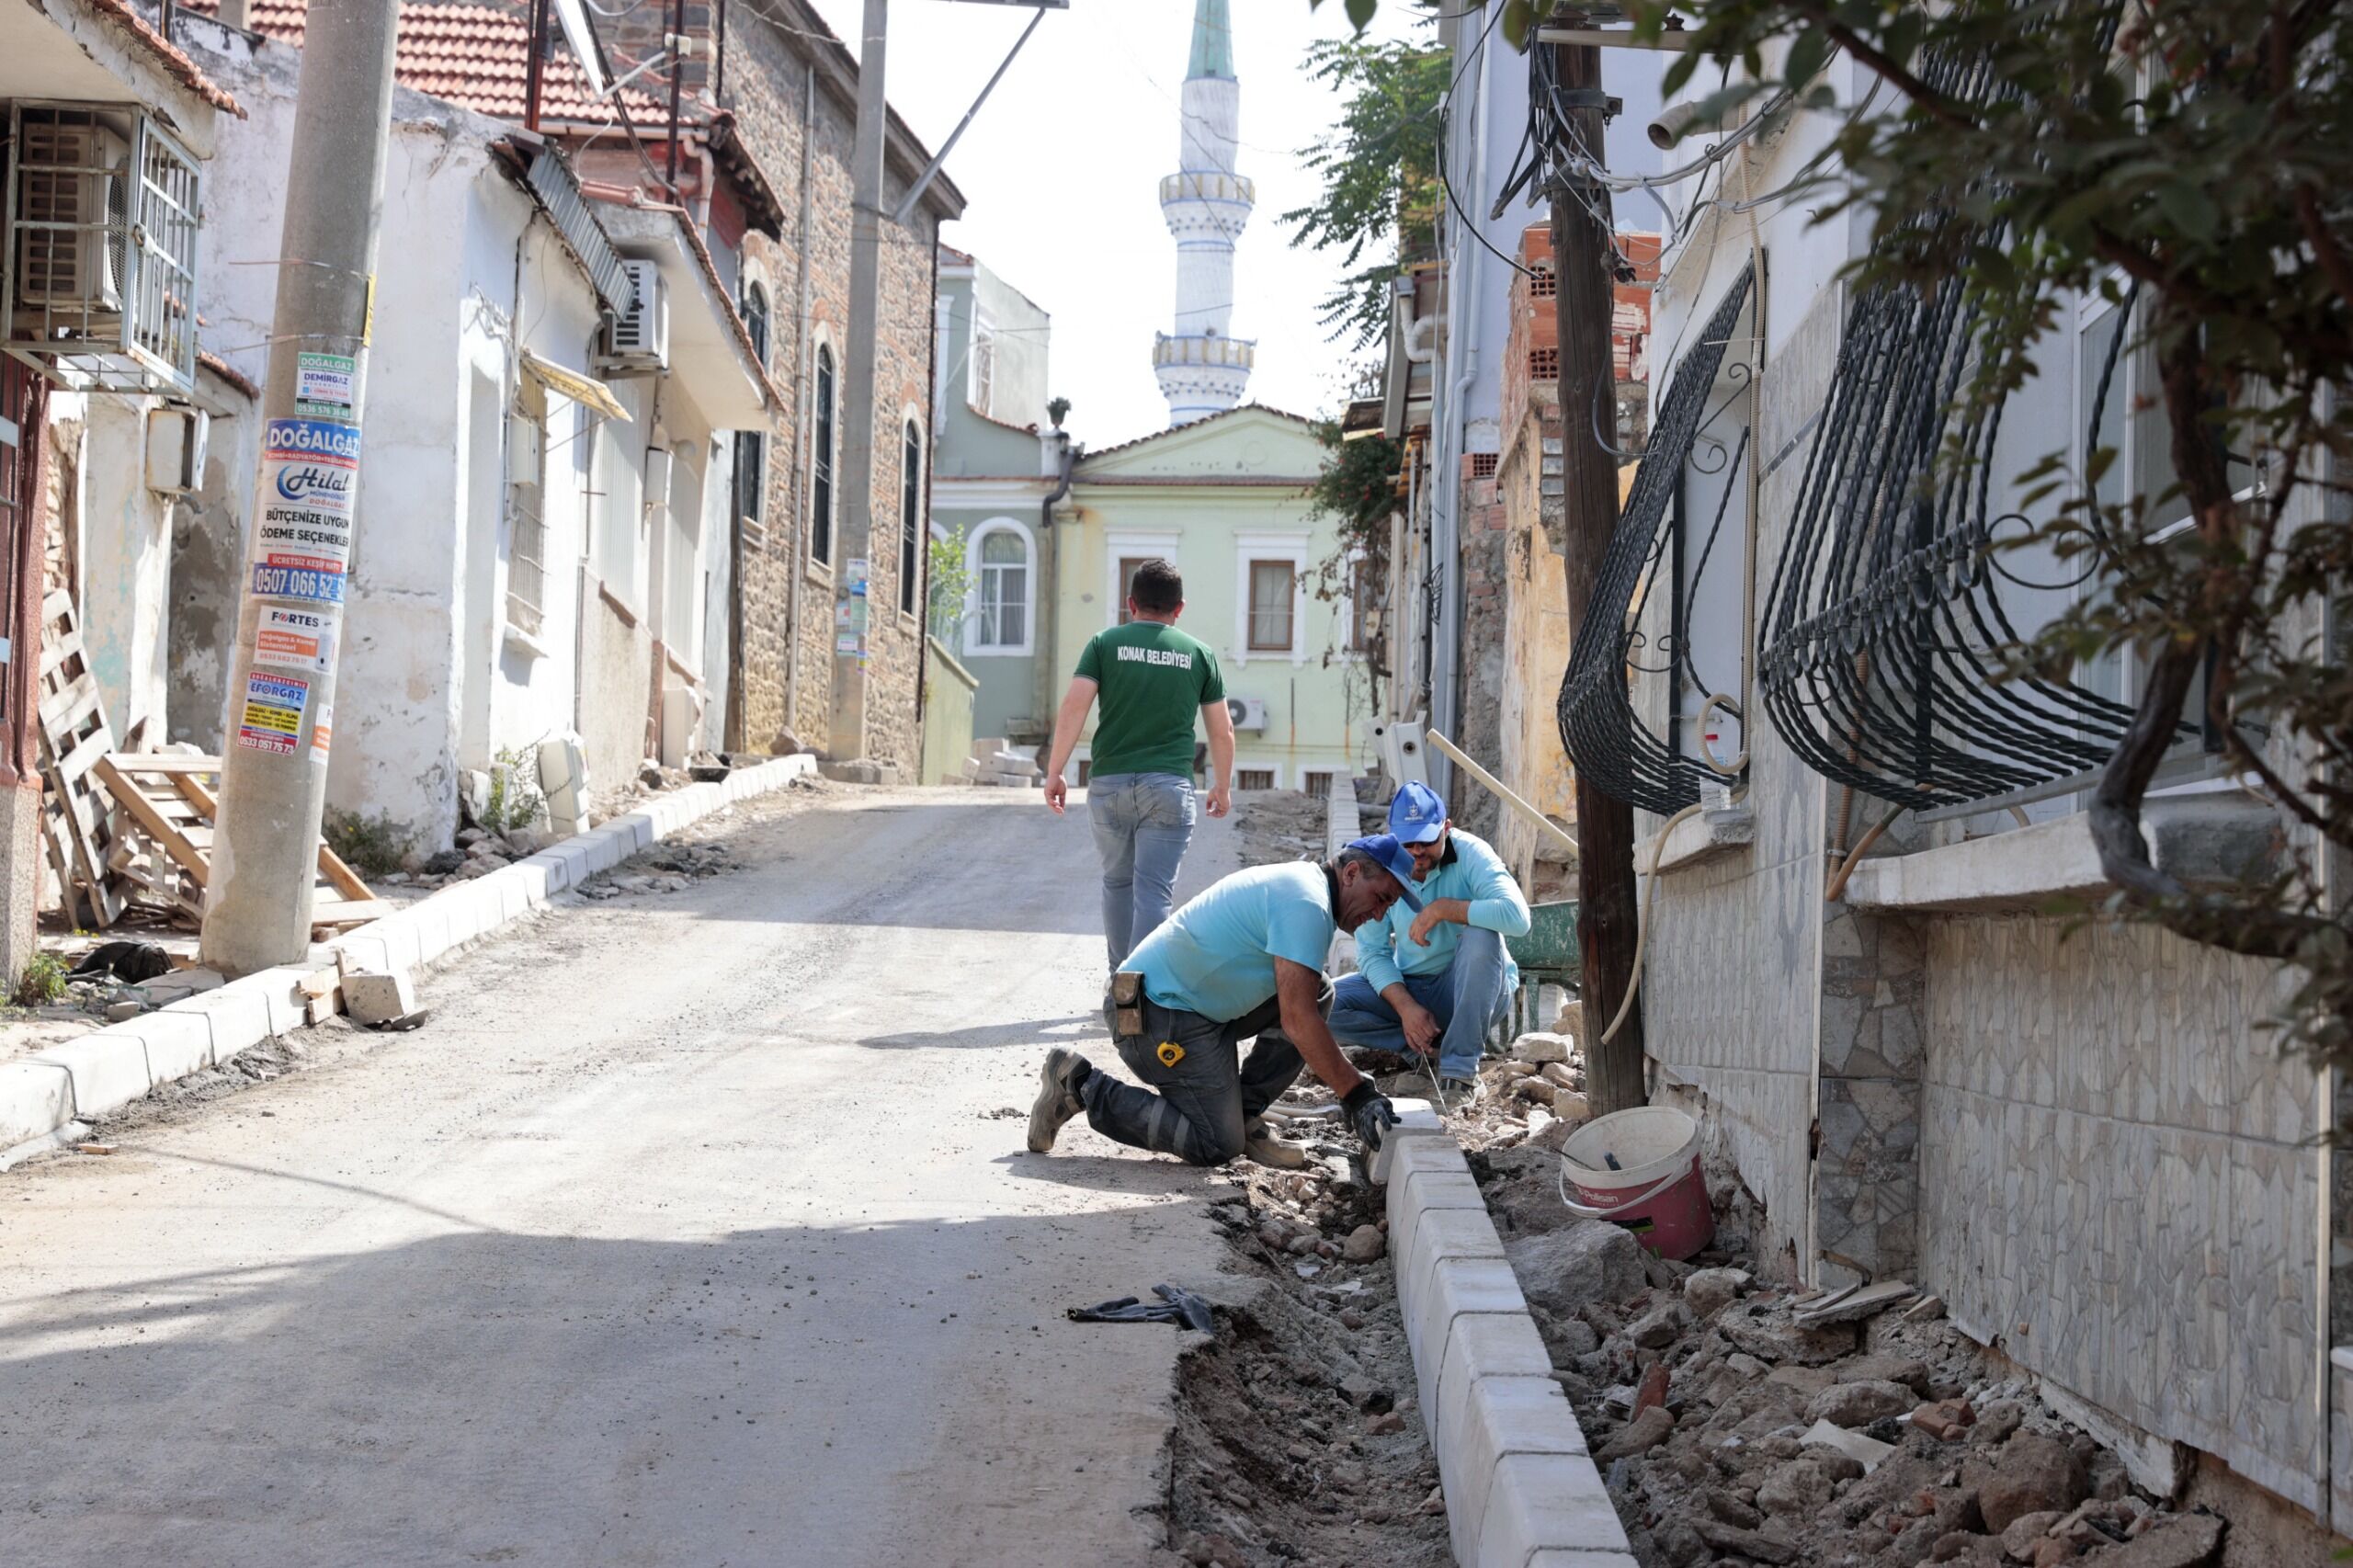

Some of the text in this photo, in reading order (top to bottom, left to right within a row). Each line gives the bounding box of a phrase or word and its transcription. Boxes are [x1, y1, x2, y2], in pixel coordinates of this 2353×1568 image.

[301, 356, 352, 371] DOĞALGAZ
[304, 371, 348, 385] DEMİRGAZ
[269, 423, 359, 457] DOĞALGAZ
[286, 467, 349, 492] Hilal
[266, 507, 349, 529] BÜTÇENİZE UYGUN
[260, 525, 294, 540] ÖDEME
[272, 555, 305, 566] ÜCRETSİZ
[256, 568, 288, 593] 0507
[290, 570, 317, 596] 066
[319, 574, 333, 598] 52
[271, 611, 319, 628] FORTES
[1118, 646, 1192, 670] KONAK BELEDİYESİ
[251, 683, 302, 700] EFORGAZ
[239, 736, 257, 746] 0533
[258, 738, 272, 749] 051
[273, 741, 283, 752] 75
[1585, 1190, 1619, 1203] Polisan
